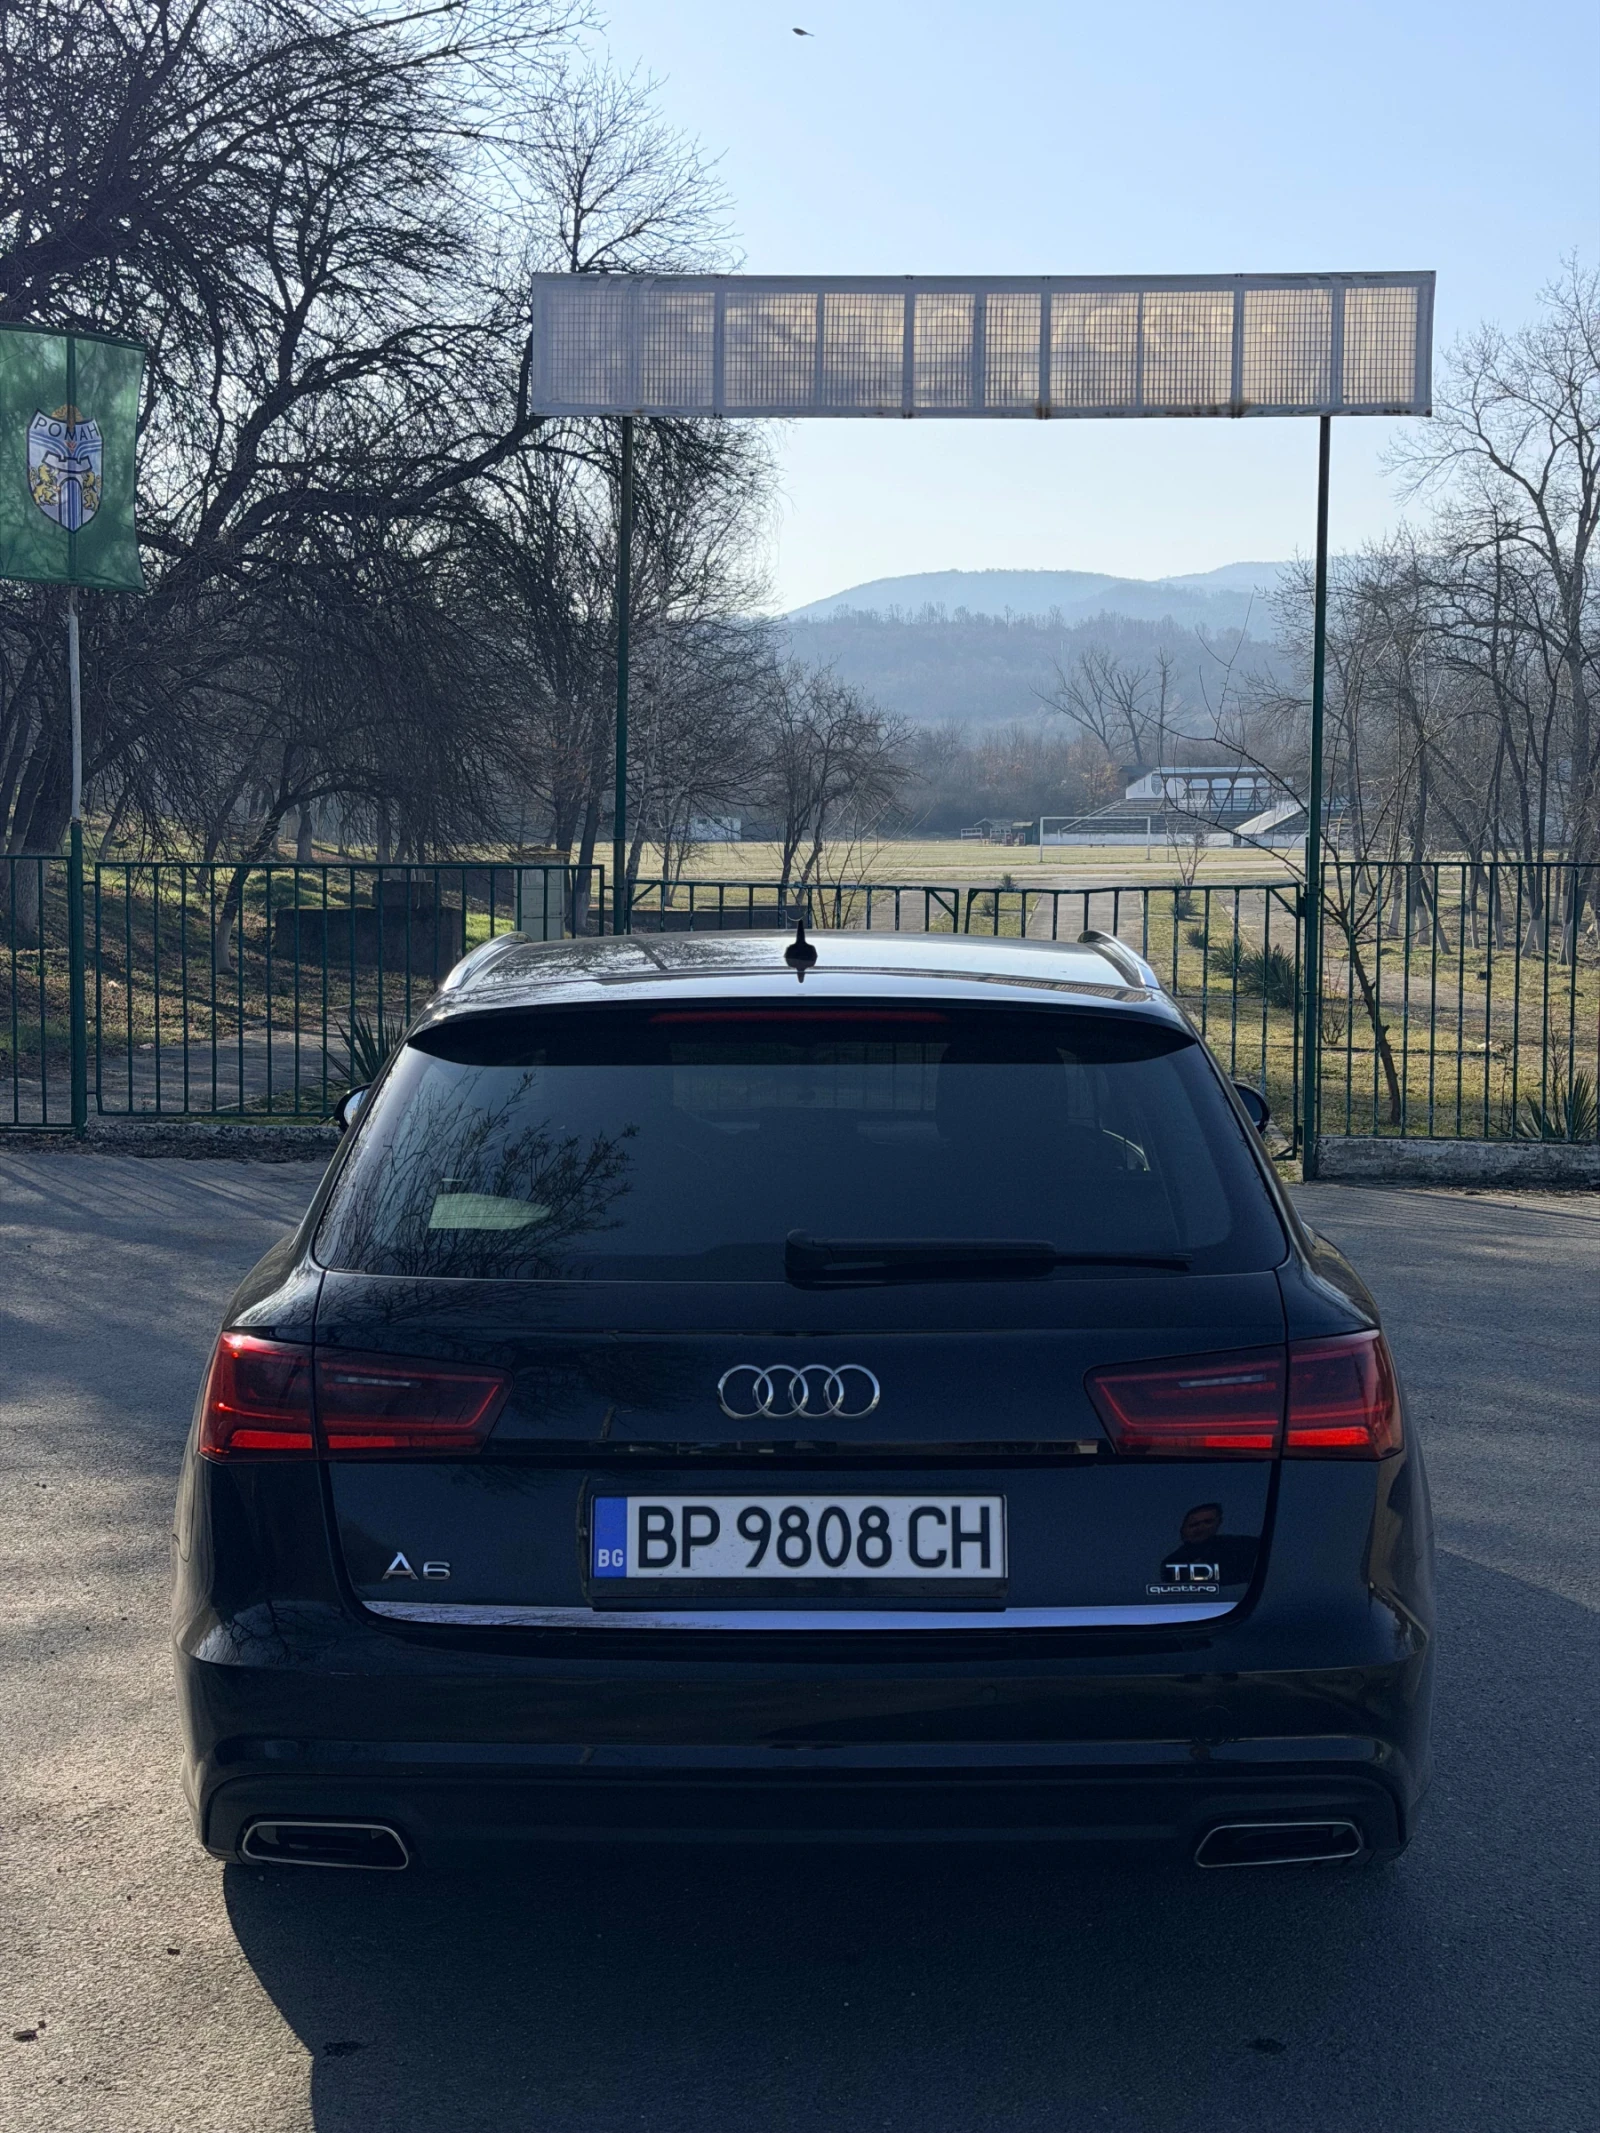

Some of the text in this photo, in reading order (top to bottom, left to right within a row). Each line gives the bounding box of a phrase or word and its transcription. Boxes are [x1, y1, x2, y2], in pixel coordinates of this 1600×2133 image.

[34, 416, 100, 441] РОМАН
[637, 1505, 991, 1569] BP 9808 CH
[381, 1551, 451, 1581] A6
[597, 1548, 624, 1568] BG
[1165, 1563, 1220, 1581] TDI
[1149, 1585, 1217, 1594] quattro
